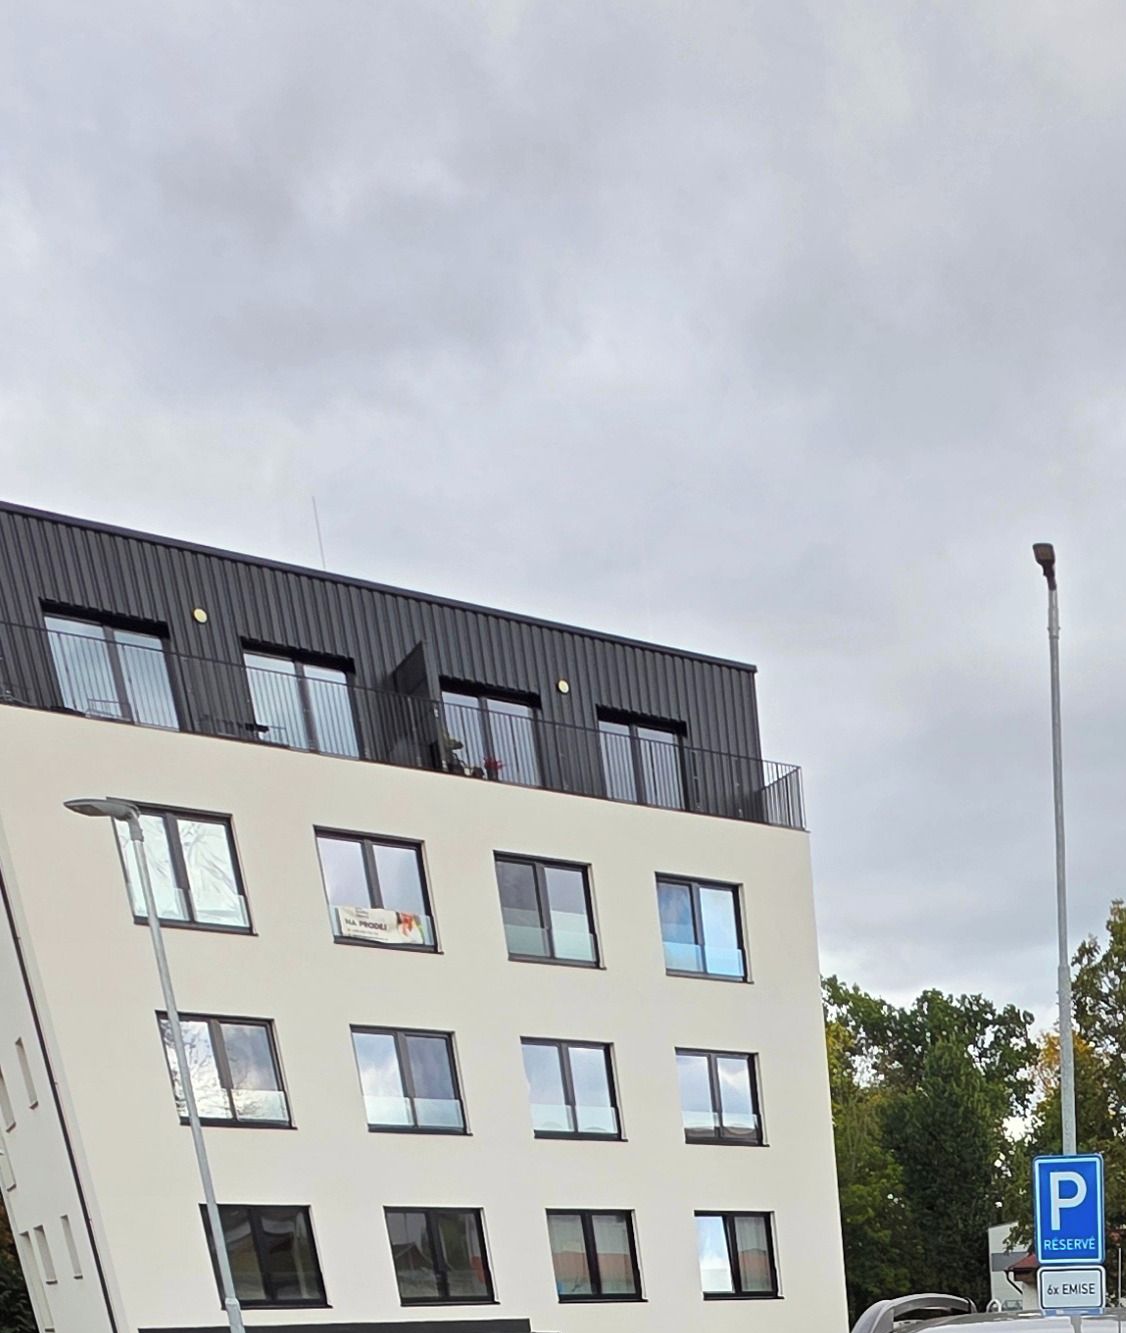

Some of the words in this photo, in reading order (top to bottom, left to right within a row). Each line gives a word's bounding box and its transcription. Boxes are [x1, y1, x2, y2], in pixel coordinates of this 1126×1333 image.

[1050, 1171, 1087, 1231] P
[1047, 1285, 1059, 1295] 6x
[1062, 1283, 1096, 1295] EMISE
